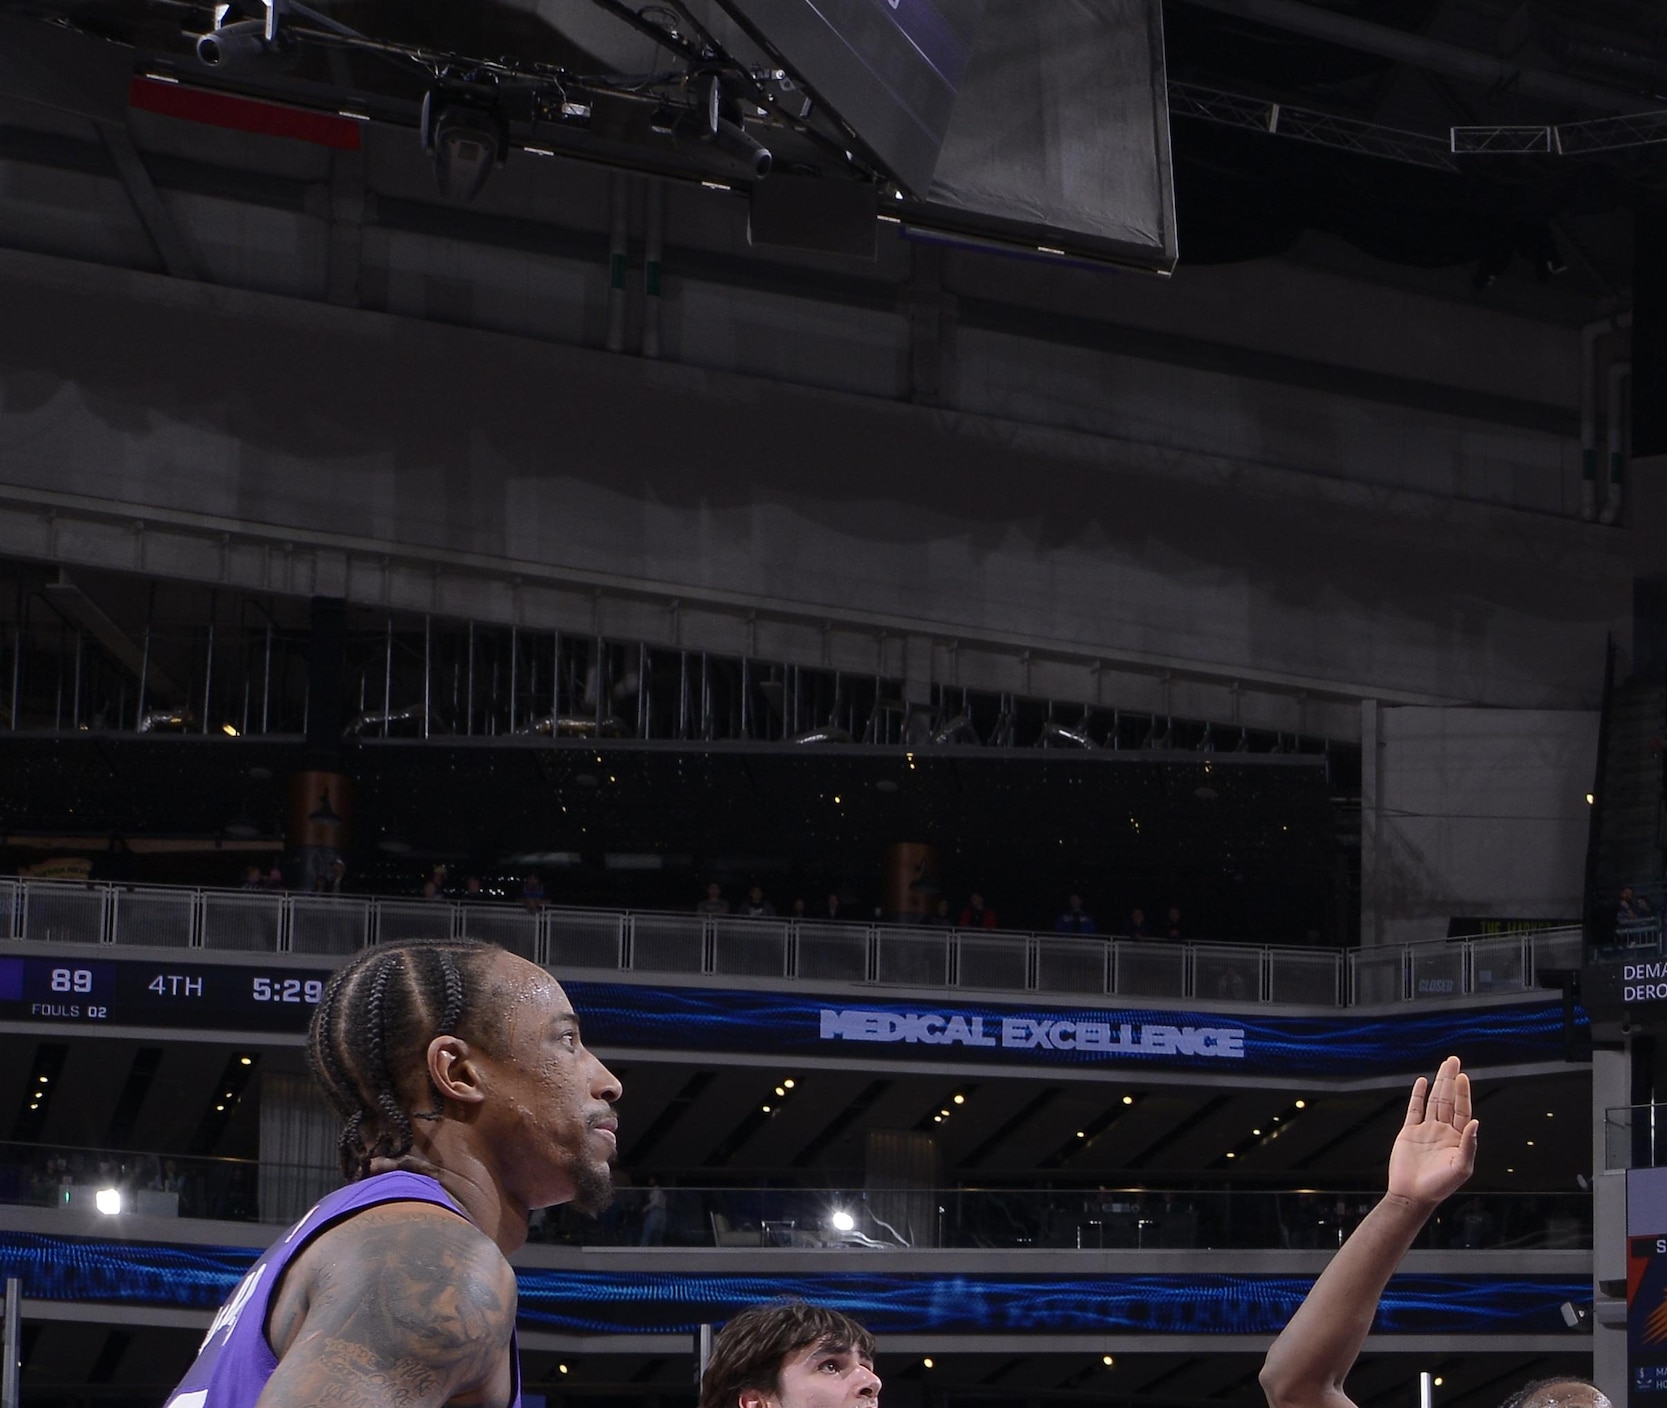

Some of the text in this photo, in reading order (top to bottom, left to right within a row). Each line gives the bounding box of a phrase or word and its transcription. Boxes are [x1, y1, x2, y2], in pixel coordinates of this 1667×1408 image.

[51, 968, 323, 1003] 89 4TH 5:29
[32, 1003, 107, 1019] FOULS 02
[820, 1009, 1245, 1058] MEDICAL EXCELLENCE
